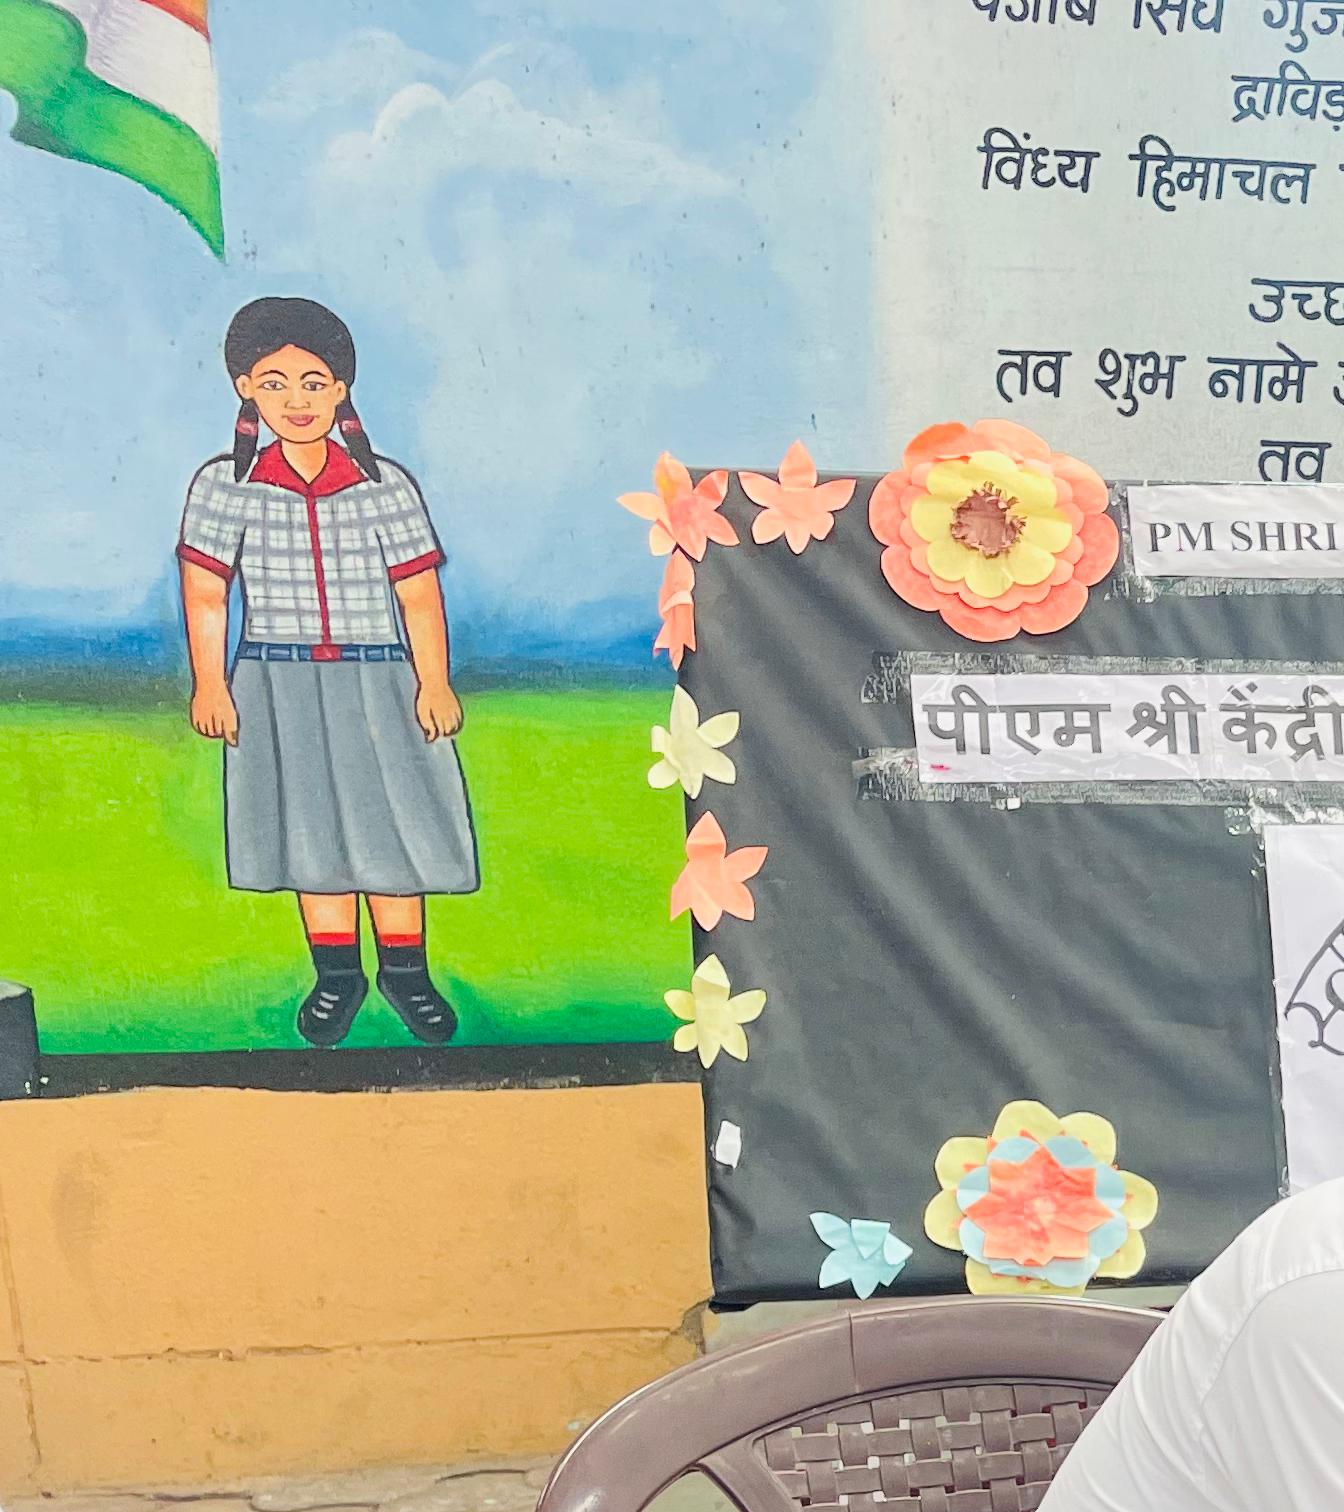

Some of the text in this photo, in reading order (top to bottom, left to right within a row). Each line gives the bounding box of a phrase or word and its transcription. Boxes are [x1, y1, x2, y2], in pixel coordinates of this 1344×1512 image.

[975, 127, 1102, 195] विंध्य
[1127, 134, 1317, 213] हिमाचल
[995, 348, 1074, 404] तव
[1093, 347, 1187, 418] शुभ
[1206, 341, 1319, 405] नामे
[1257, 439, 1333, 484] तव
[1148, 520, 1214, 554] PM
[1229, 520, 1338, 554] SHRI
[921, 683, 1112, 756] पीएम
[1125, 683, 1207, 756] श्री
